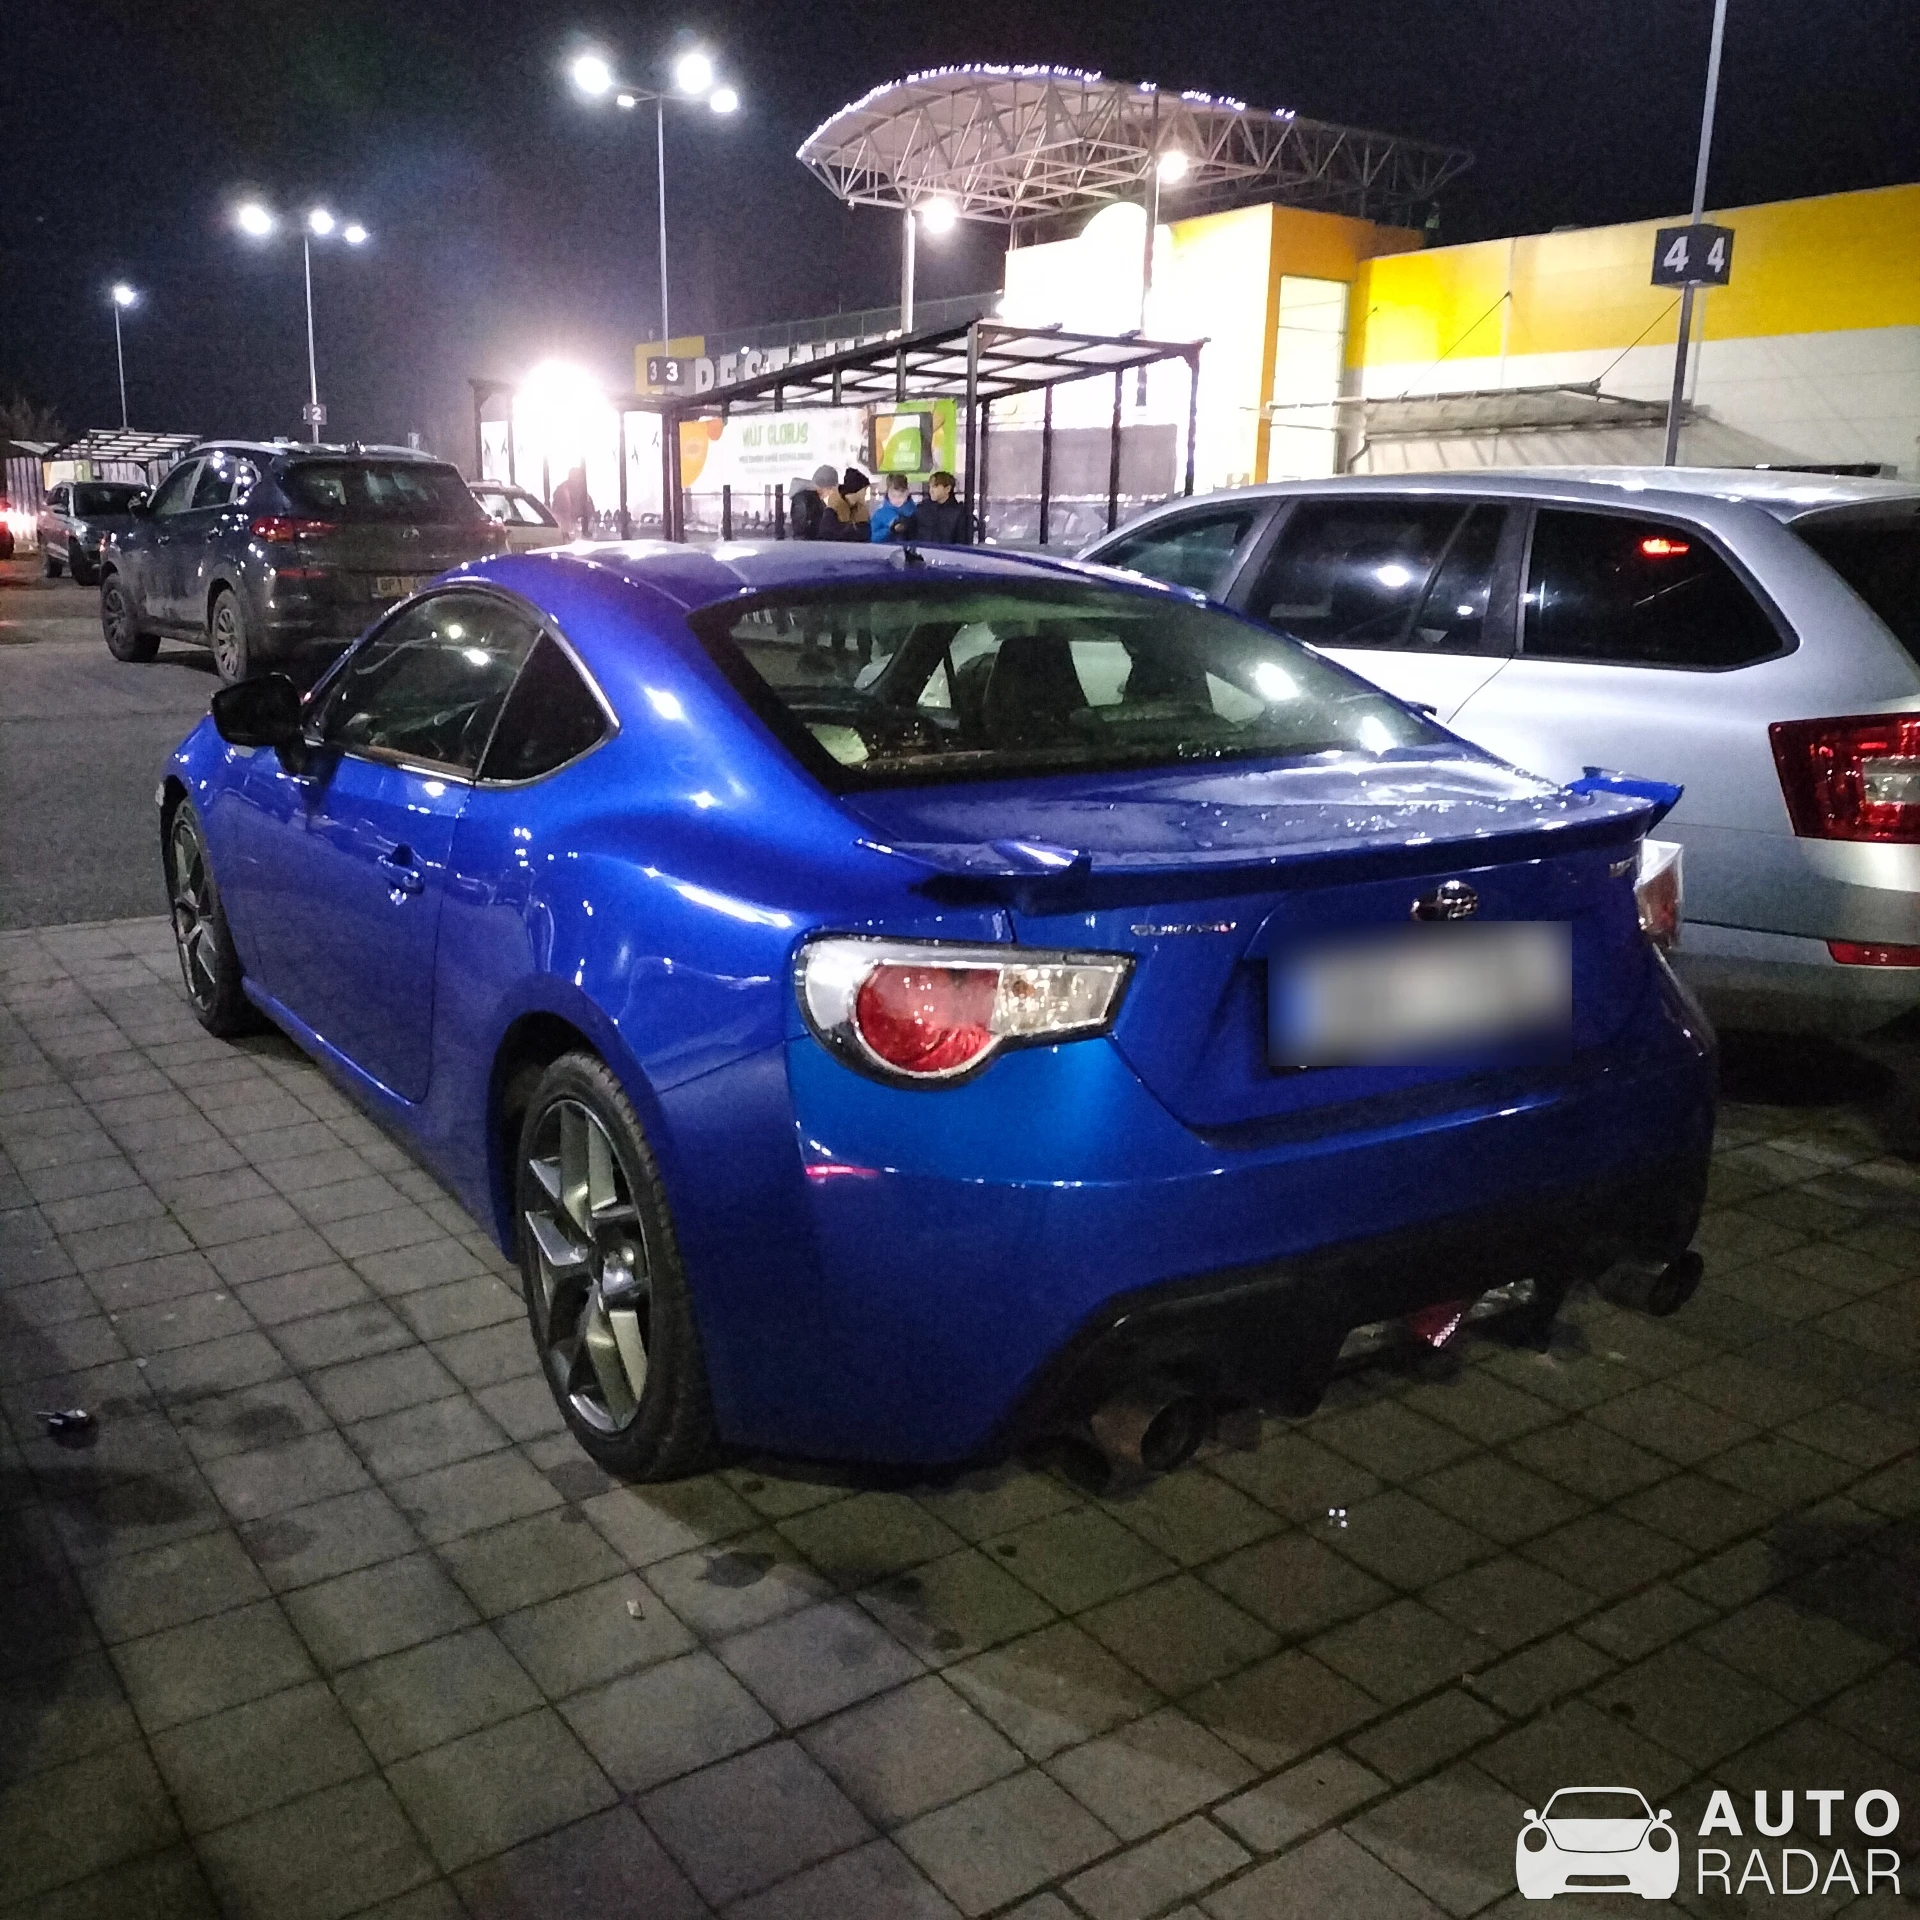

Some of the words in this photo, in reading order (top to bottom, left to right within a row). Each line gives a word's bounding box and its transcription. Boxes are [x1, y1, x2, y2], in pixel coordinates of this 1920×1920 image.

[1663, 236, 1690, 273] 4
[1706, 237, 1725, 273] 4
[649, 361, 658, 381] 3
[666, 361, 679, 382] 3
[312, 406, 322, 421] 2
